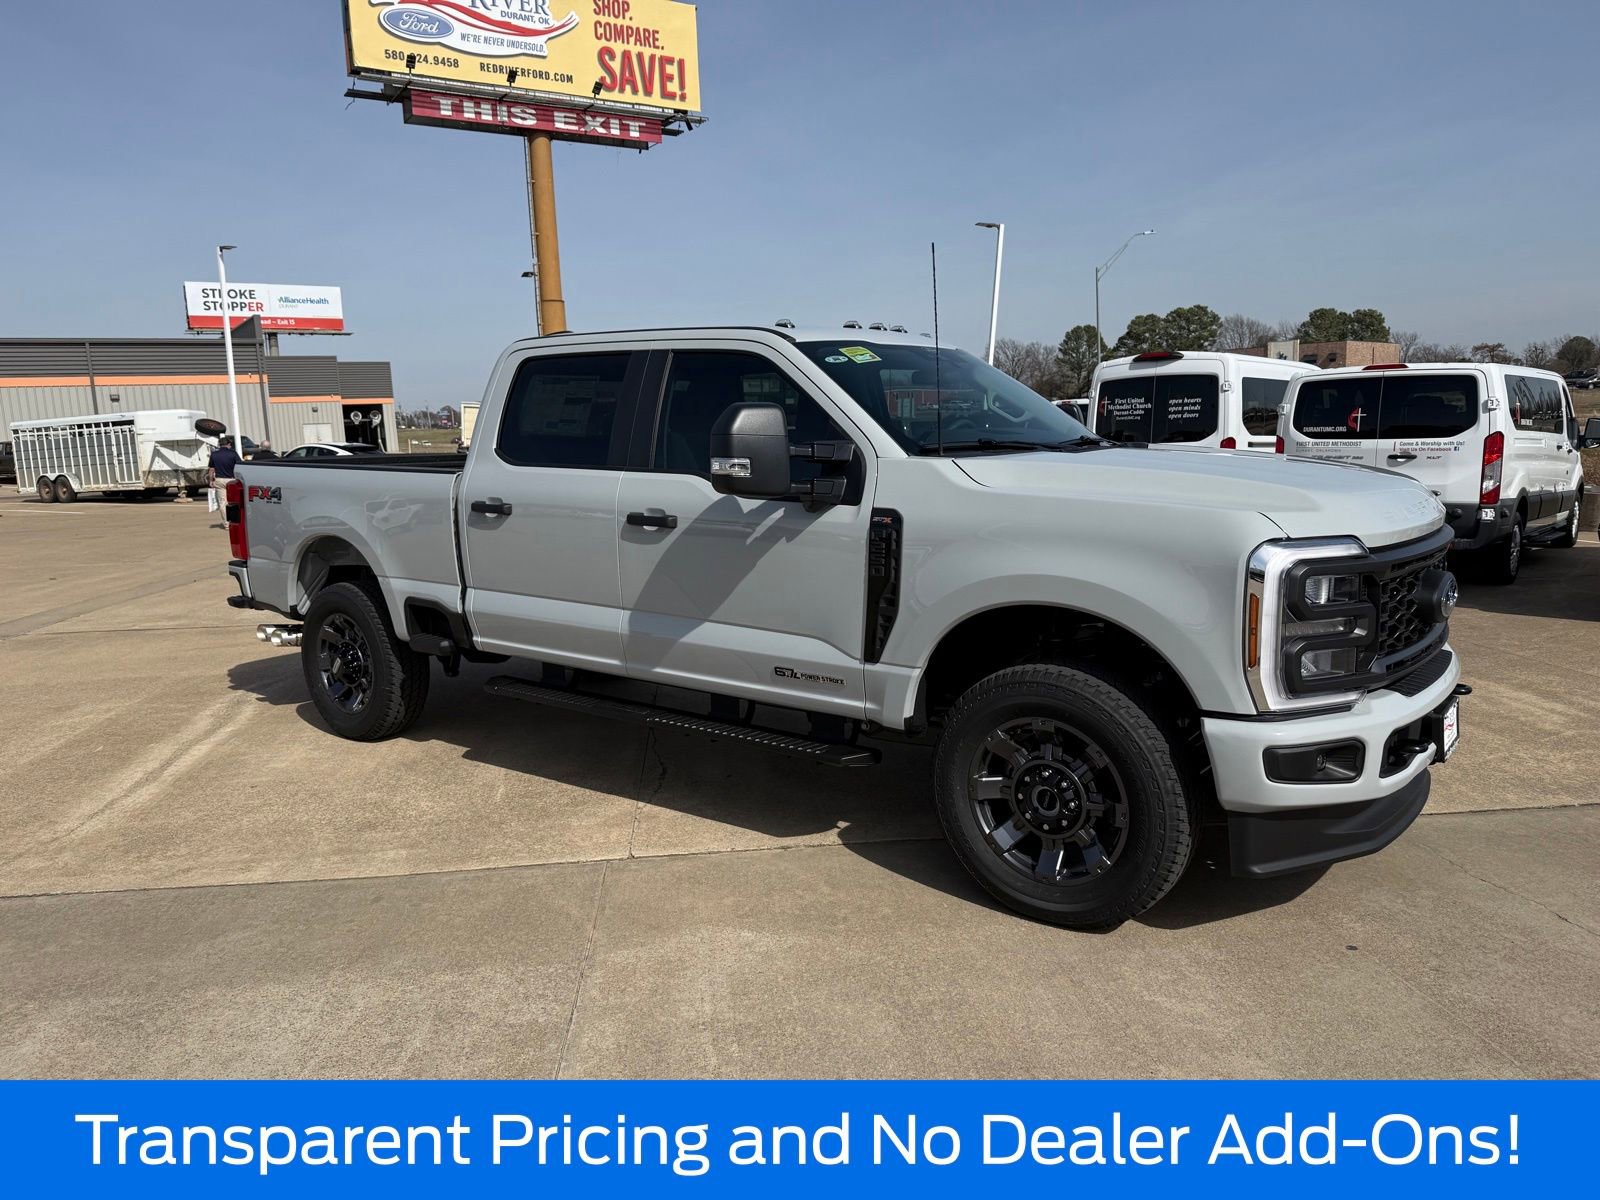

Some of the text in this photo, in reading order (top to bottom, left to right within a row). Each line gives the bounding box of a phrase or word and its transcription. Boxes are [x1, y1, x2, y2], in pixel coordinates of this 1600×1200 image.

[500, 10, 550, 25] DURANT, OK
[593, 0, 632, 21] SHOP.
[399, 12, 439, 33] Ford
[460, 32, 546, 53] WE'RE NEVER UNDERSOLD.
[593, 20, 664, 50] COMPARE.
[597, 46, 686, 102] SAVE!
[430, 95, 647, 138] THIS EXIT
[277, 296, 330, 305] AllianceHealth
[248, 485, 282, 502] FX4
[774, 666, 800, 679] 6.7L
